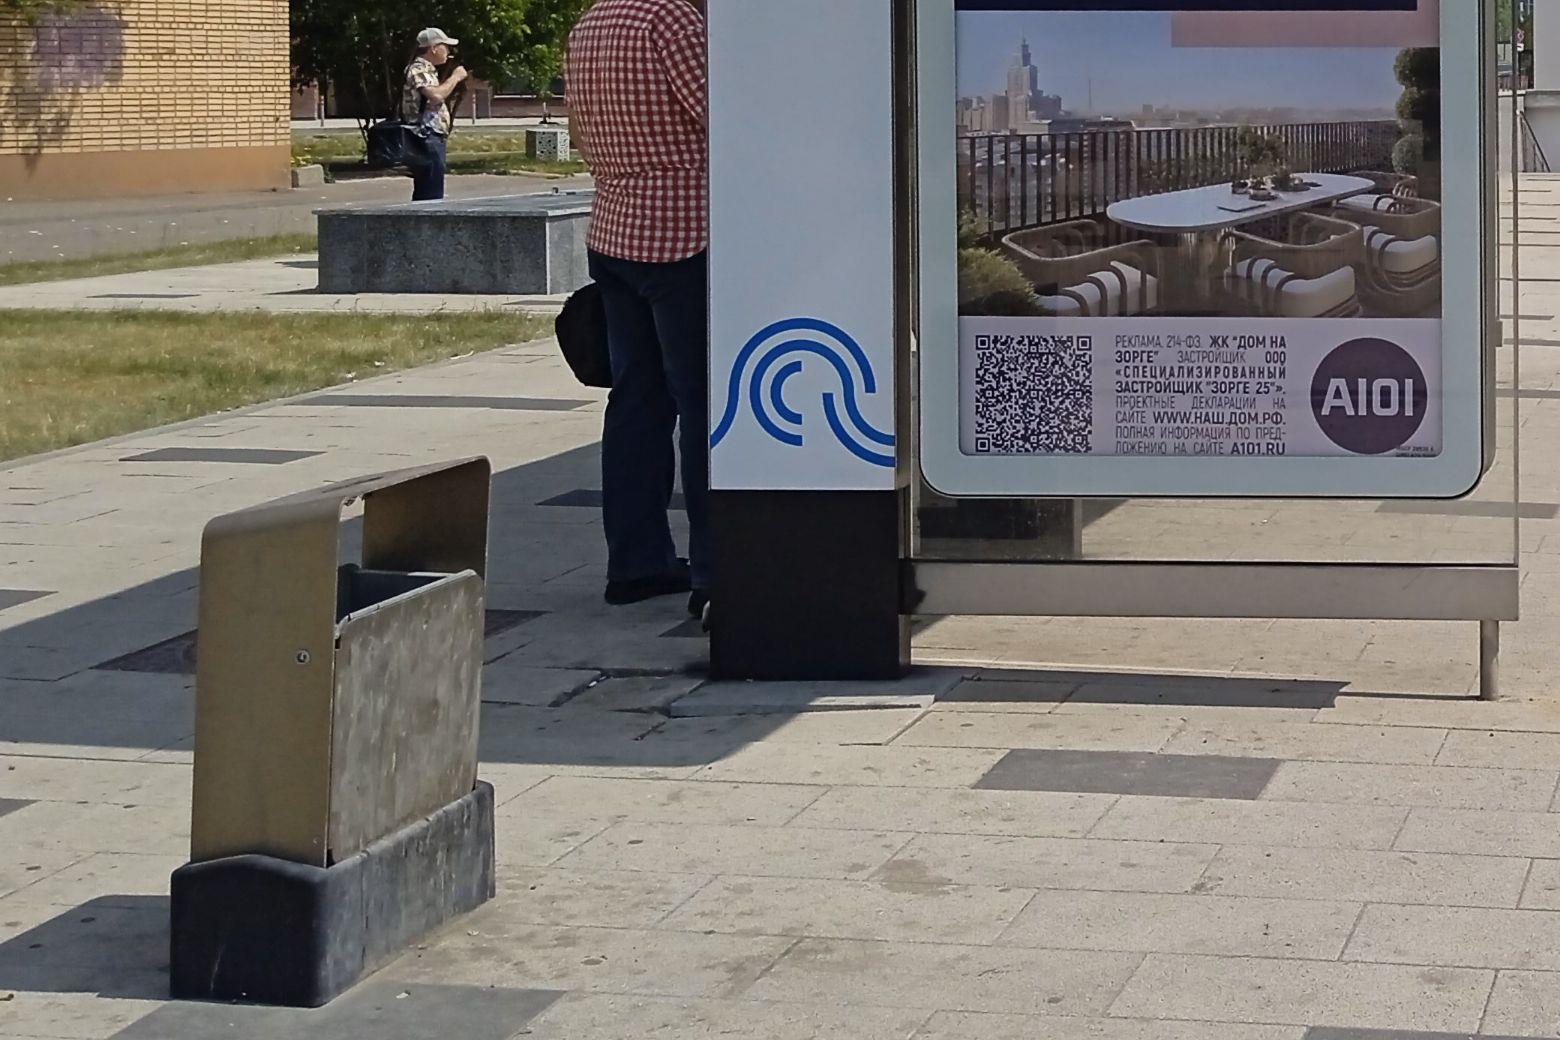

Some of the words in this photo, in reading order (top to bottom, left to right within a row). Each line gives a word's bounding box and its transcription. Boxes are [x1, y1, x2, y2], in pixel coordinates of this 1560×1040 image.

[1209, 335, 1230, 348] ЖК
[1270, 336, 1287, 348] НА
[1177, 348, 1247, 364] ЗАСТРОЙЩИК
[1265, 351, 1287, 364] ООО
[1115, 364, 1287, 380] «СПЕЦИАЛИЗИРОВАННЫЙ
[1115, 378, 1203, 395] ЗАСТРОЙЩИК
[1115, 395, 1176, 409] ПРОЕКТНЫЕ
[1191, 395, 1257, 410] ДЕКЛАРАЦИИ
[1273, 397, 1287, 409] НА
[1115, 409, 1147, 424] САЙТЕ
[1115, 426, 1155, 439] ПОЛНАЯ
[1160, 426, 1231, 441] ИНФОРМАЦИЯ
[1236, 427, 1250, 439] ПО
[1115, 442, 1167, 455] ЛОЖЕНИЮ
[1173, 443, 1187, 455] НА
[1193, 440, 1224, 455] САЙТЕ
